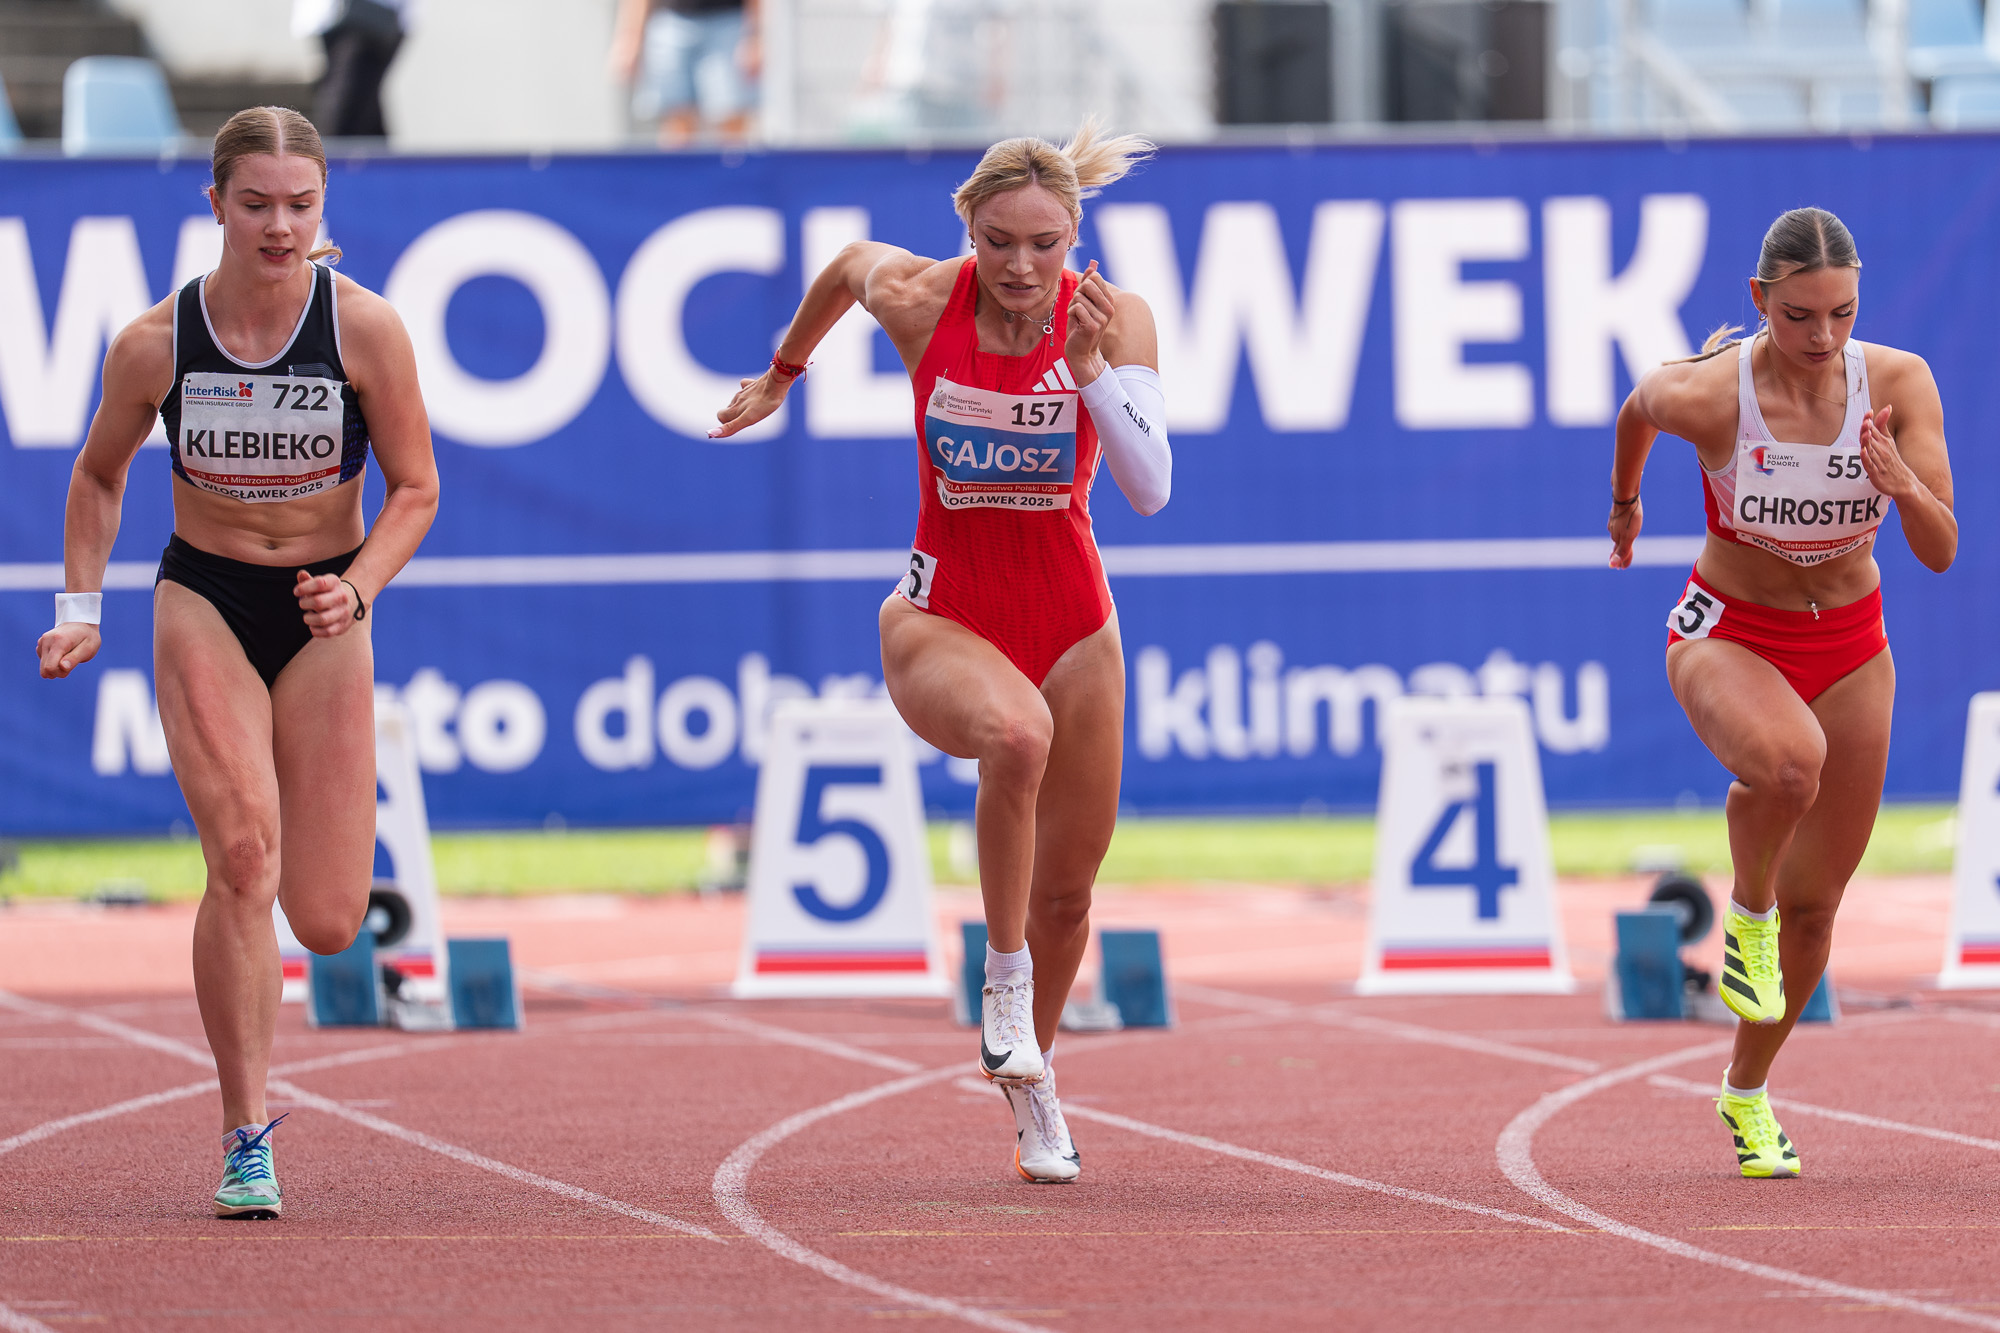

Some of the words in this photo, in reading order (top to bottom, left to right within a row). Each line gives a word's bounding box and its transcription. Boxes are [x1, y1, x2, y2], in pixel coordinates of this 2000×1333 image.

[185, 385, 237, 397] InterRisk
[272, 383, 329, 412] 722
[947, 395, 982, 406] Ministerstwo
[946, 402, 964, 411] Sportu
[968, 405, 993, 414] Turystyki
[1011, 401, 1064, 427] 157
[1122, 401, 1151, 438] ALLSIX
[186, 429, 335, 460] KLEBIEKO
[936, 436, 1061, 473] GAJOSZ
[1767, 453, 1794, 461] KUJAWY
[1766, 460, 1800, 468] POMORZE
[1826, 454, 1870, 480] 55
[200, 481, 289, 499] WŁOCŁAWEK
[291, 480, 324, 497] 2025
[209, 474, 229, 483] PZLA
[231, 476, 283, 485] Mistrzostwa
[284, 475, 310, 484] Polski
[310, 470, 327, 479] U20
[945, 481, 961, 492] ZLA
[962, 484, 1013, 492] Mistrzostwa
[1020, 496, 1054, 507] 2025
[1740, 494, 1882, 525] CHROSTEK
[1751, 536, 1833, 563] WŁOCŁAWEK
[1833, 539, 1860, 556] 2025
[1780, 541, 1831, 550] Mistrzostwa
[1678, 591, 1714, 634] 5
[792, 765, 890, 923] 5
[1410, 761, 1519, 921] 4
